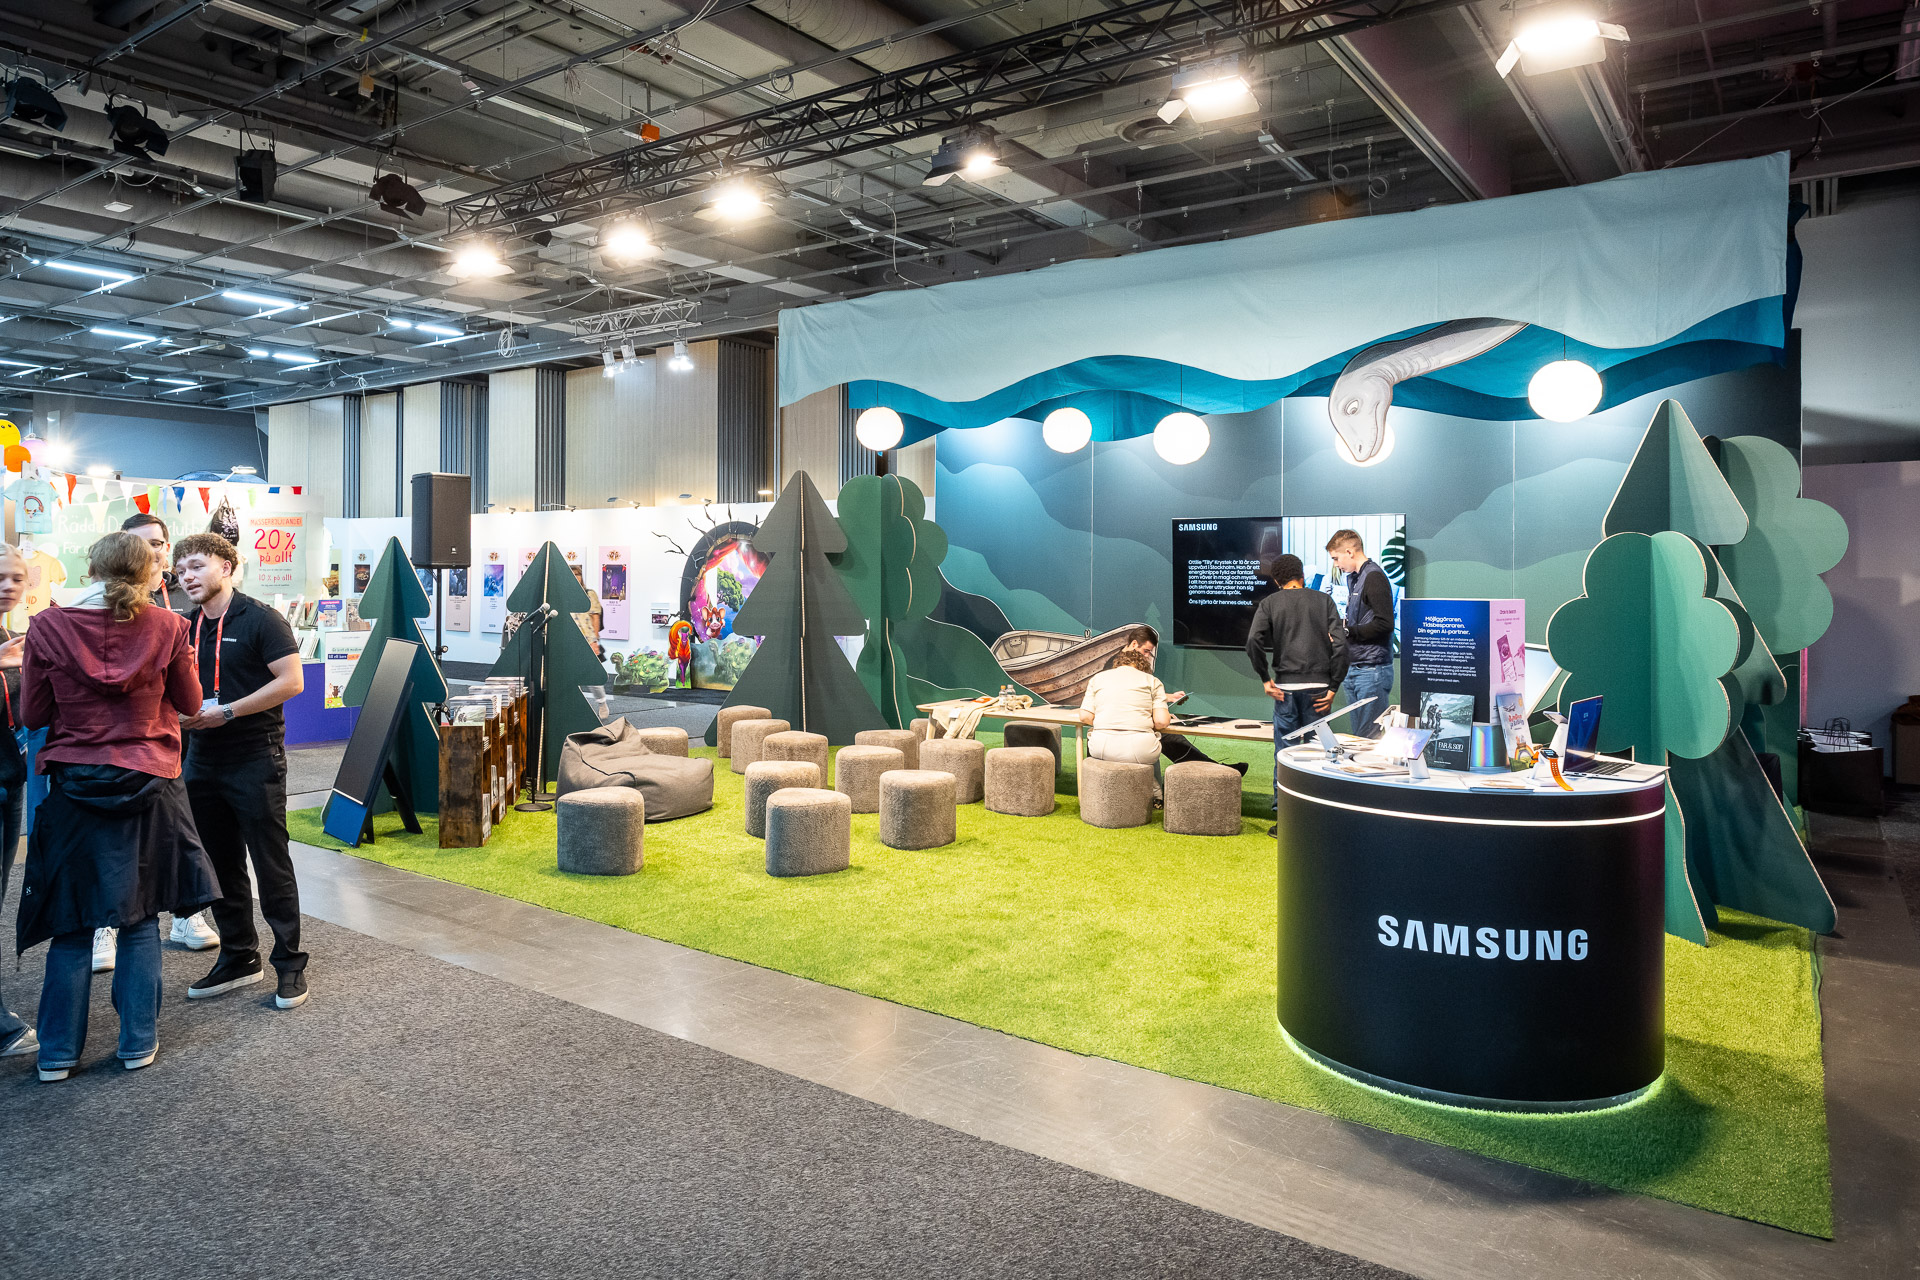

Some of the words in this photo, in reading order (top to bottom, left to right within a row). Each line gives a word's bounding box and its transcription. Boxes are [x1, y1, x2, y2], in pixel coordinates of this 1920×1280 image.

[255, 529, 280, 549] 20
[285, 532, 296, 550] %
[260, 552, 270, 567] på
[275, 551, 292, 562] allt
[1378, 915, 1588, 961] SAMSUNG
